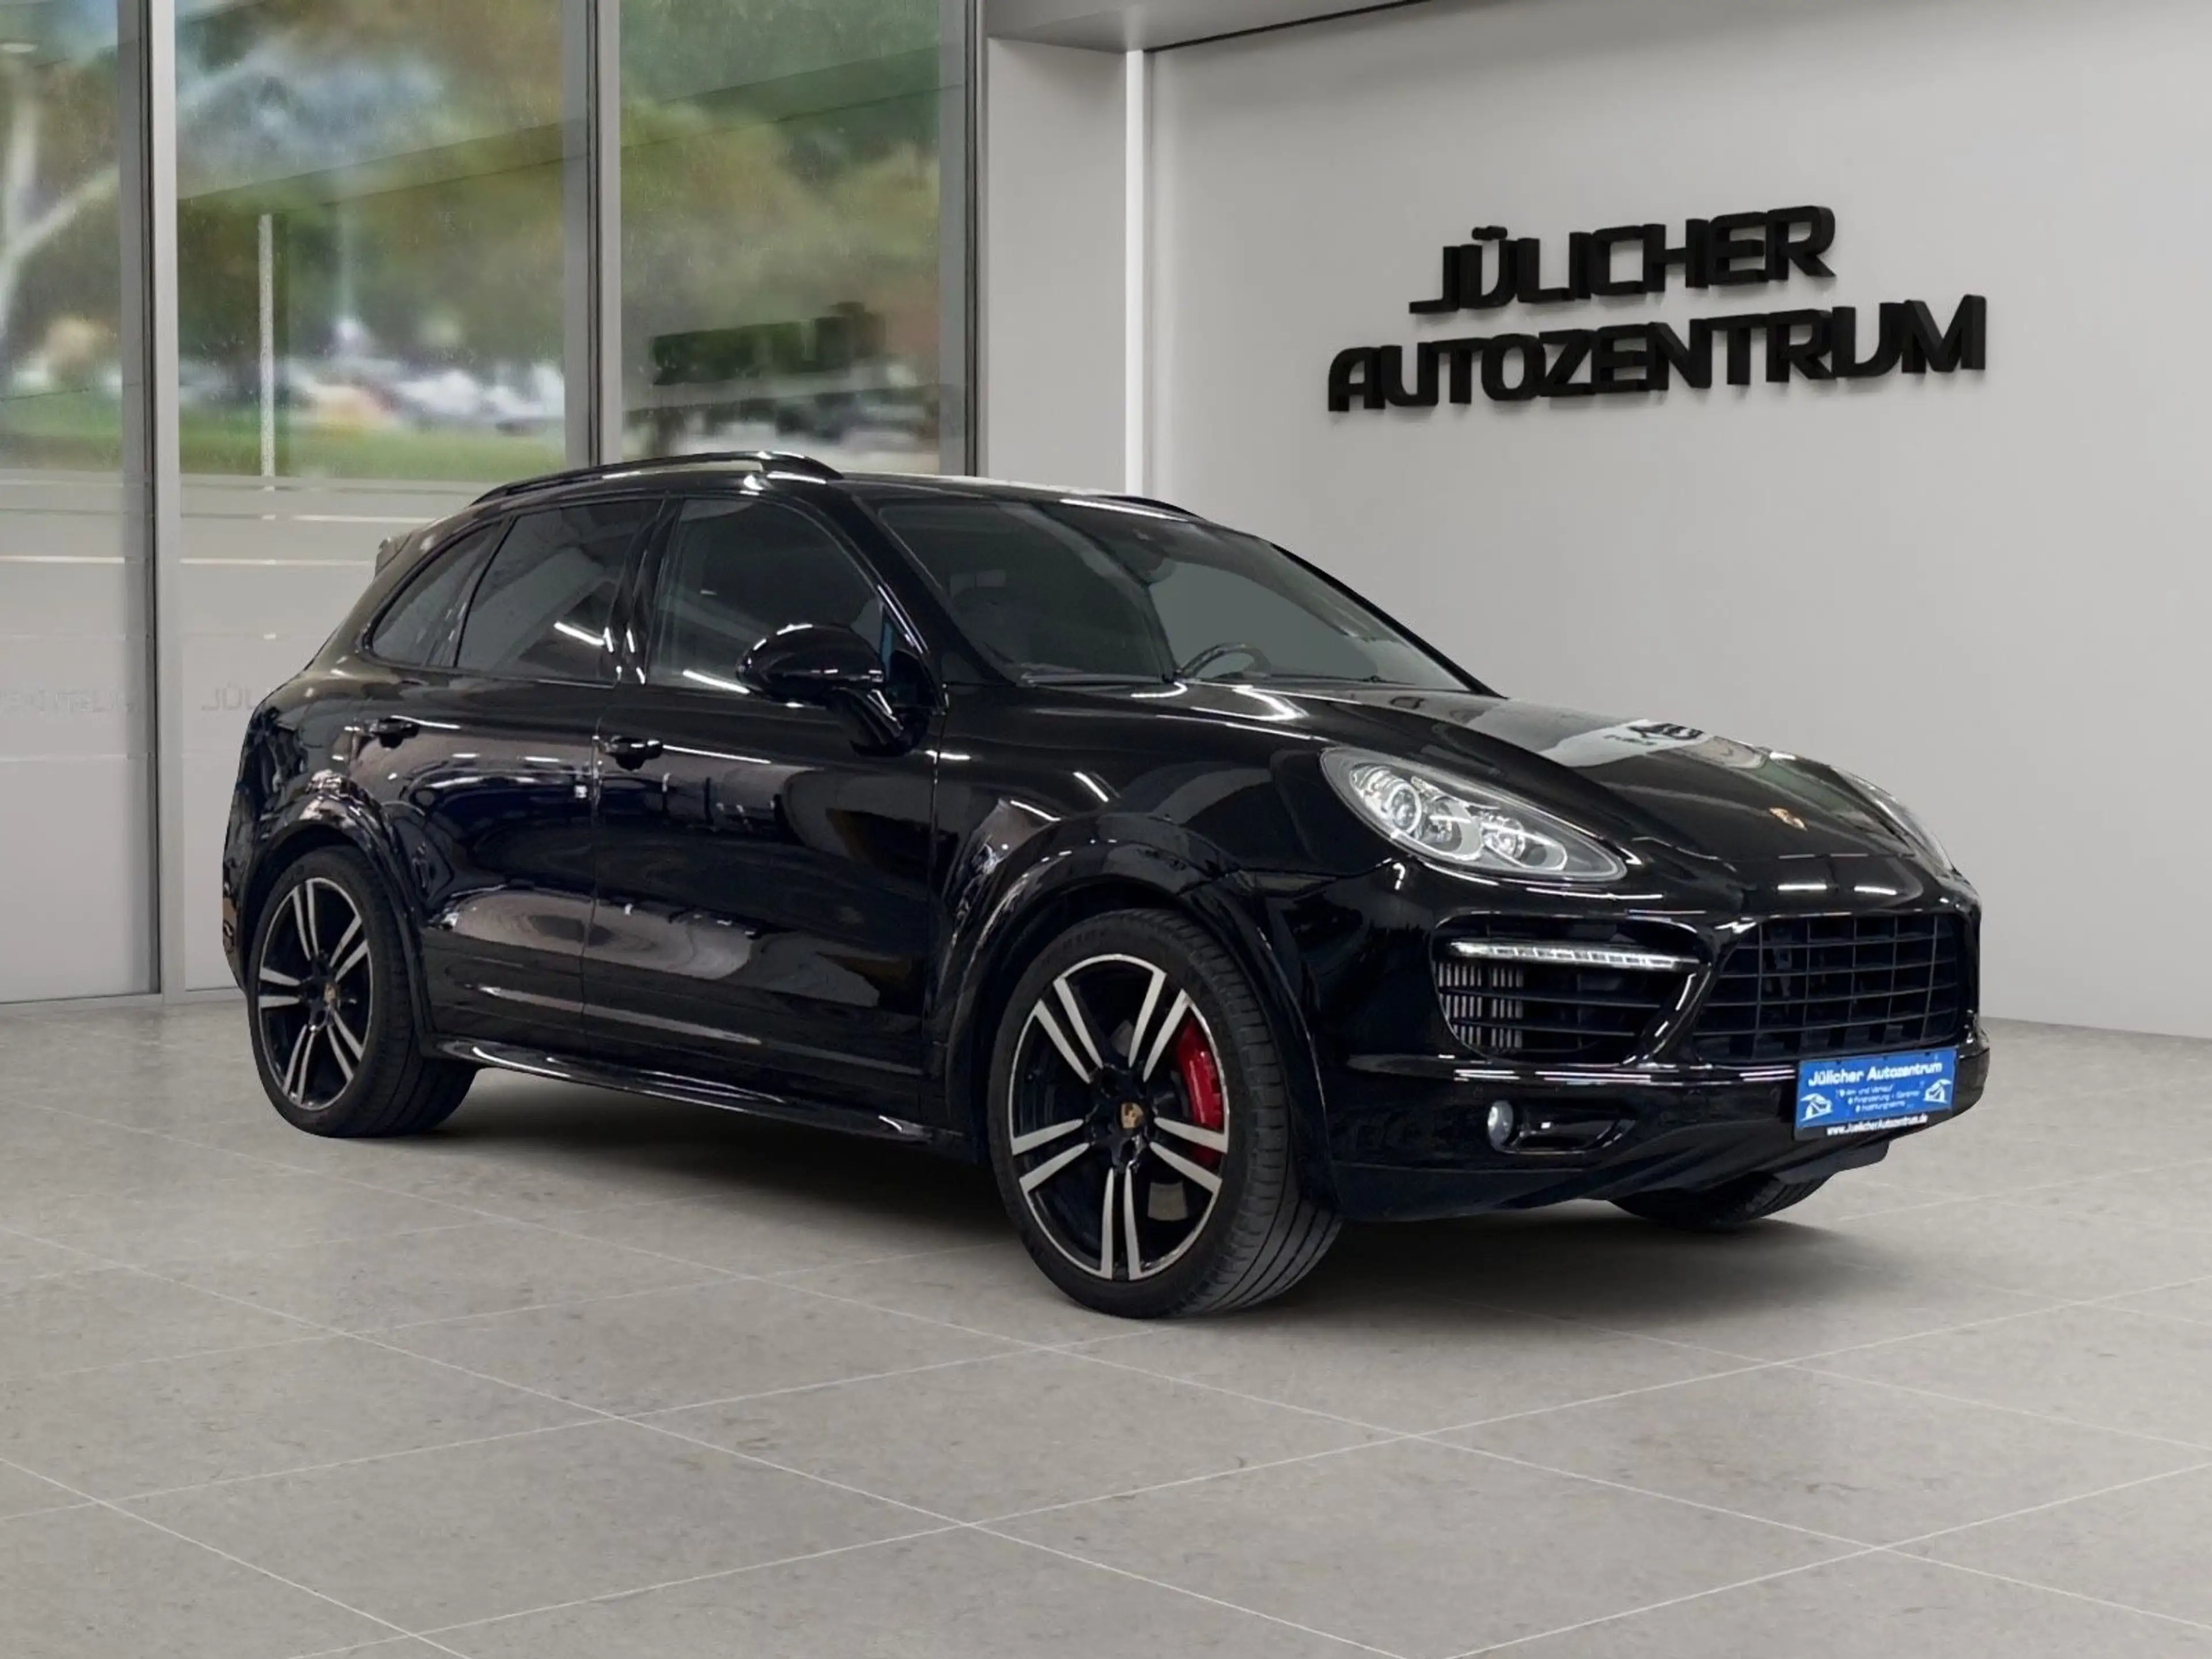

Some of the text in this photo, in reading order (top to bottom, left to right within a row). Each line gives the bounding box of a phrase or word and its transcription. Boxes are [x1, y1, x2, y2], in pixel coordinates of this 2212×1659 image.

[1410, 206, 1835, 315] JÜLICHER
[1328, 295, 1986, 412] AUTOZENTRUM
[1808, 1062, 1943, 1086] Jülicher Autozentrum
